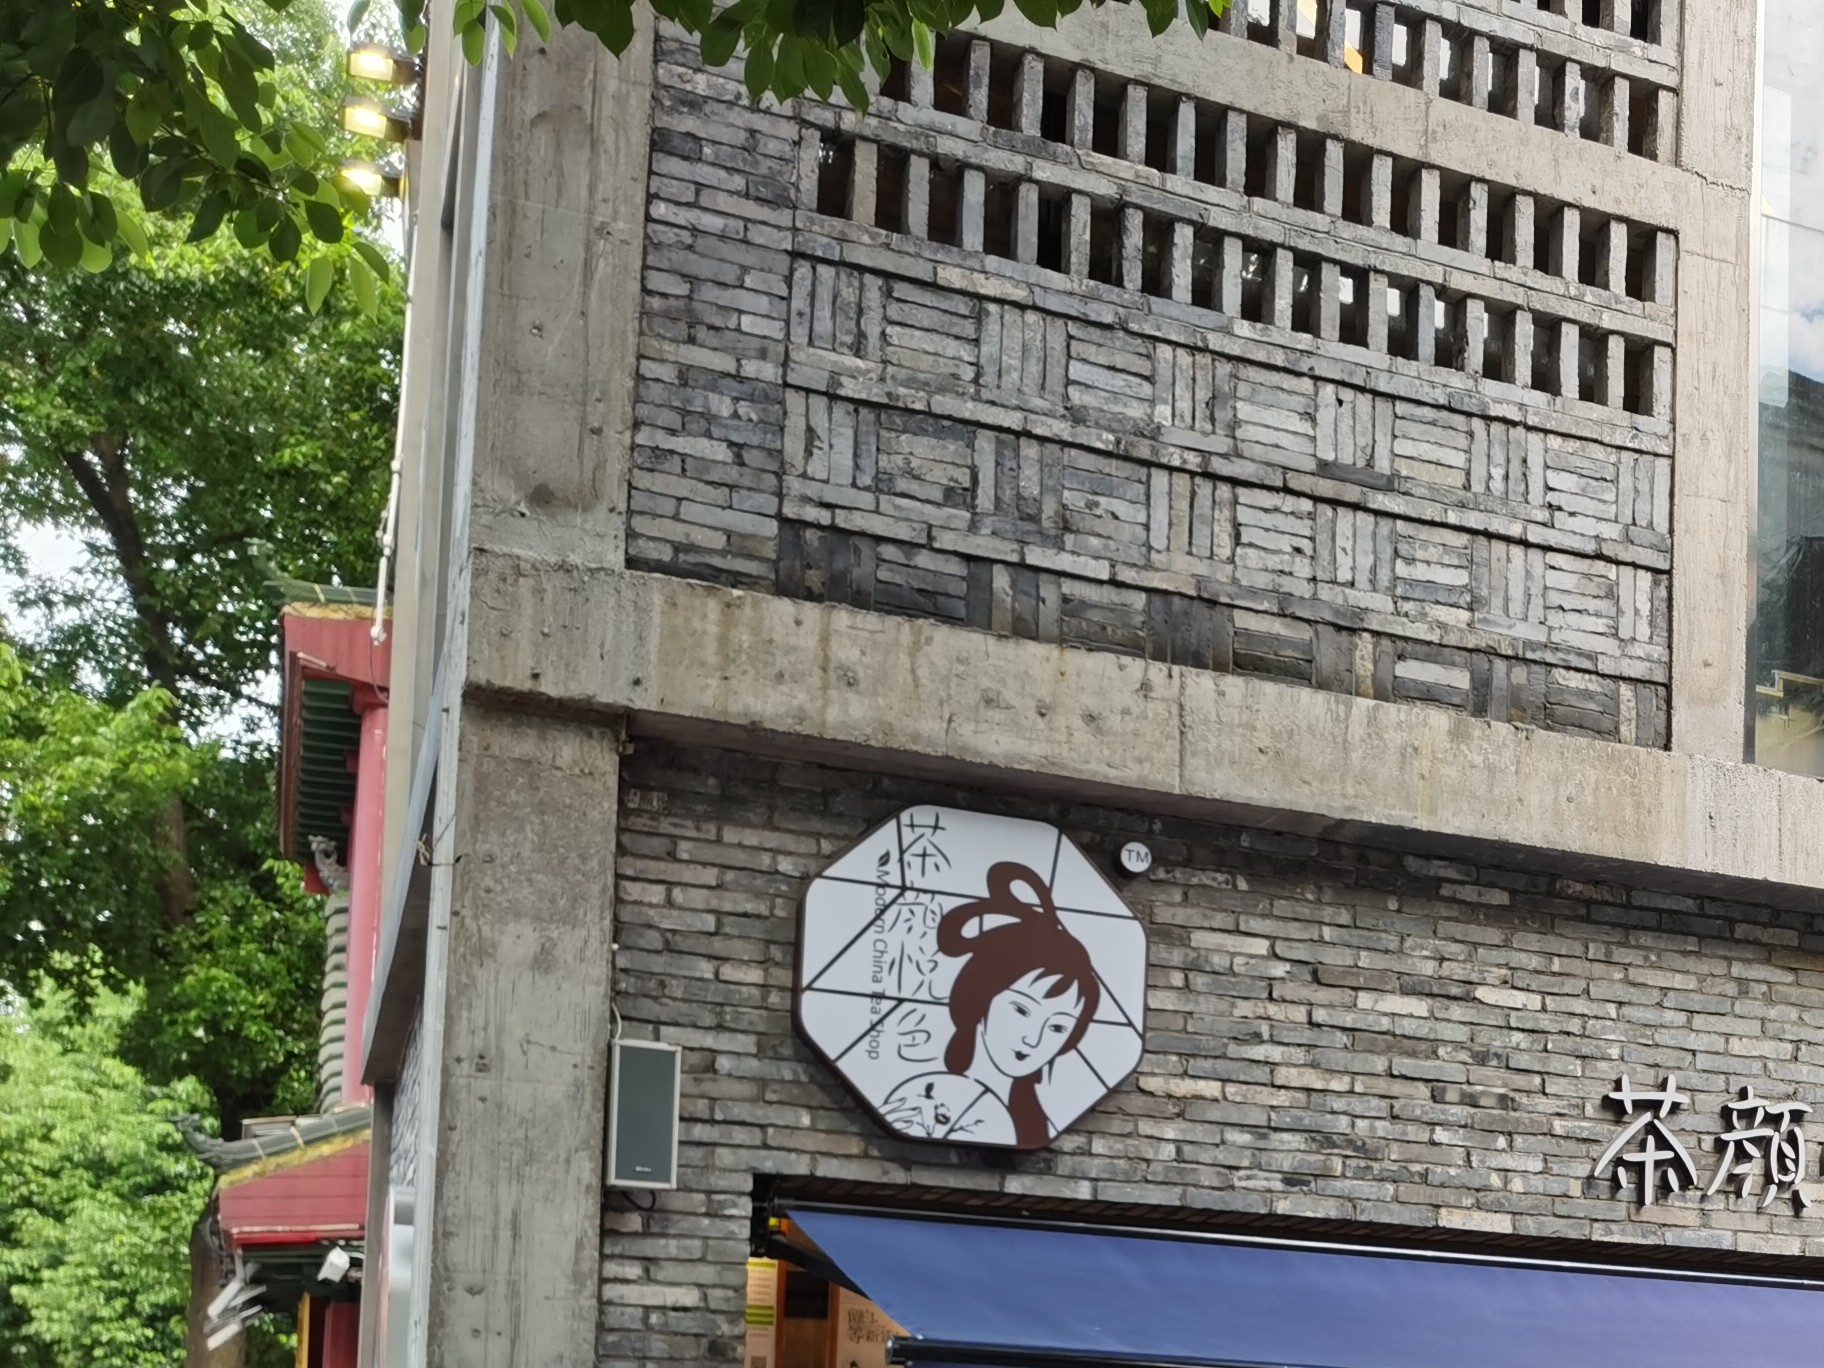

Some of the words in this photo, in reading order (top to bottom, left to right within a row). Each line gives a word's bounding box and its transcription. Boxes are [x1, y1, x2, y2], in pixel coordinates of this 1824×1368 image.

[1124, 848, 1150, 865] TM
[873, 868, 890, 934] Modern
[871, 938, 889, 986] China
